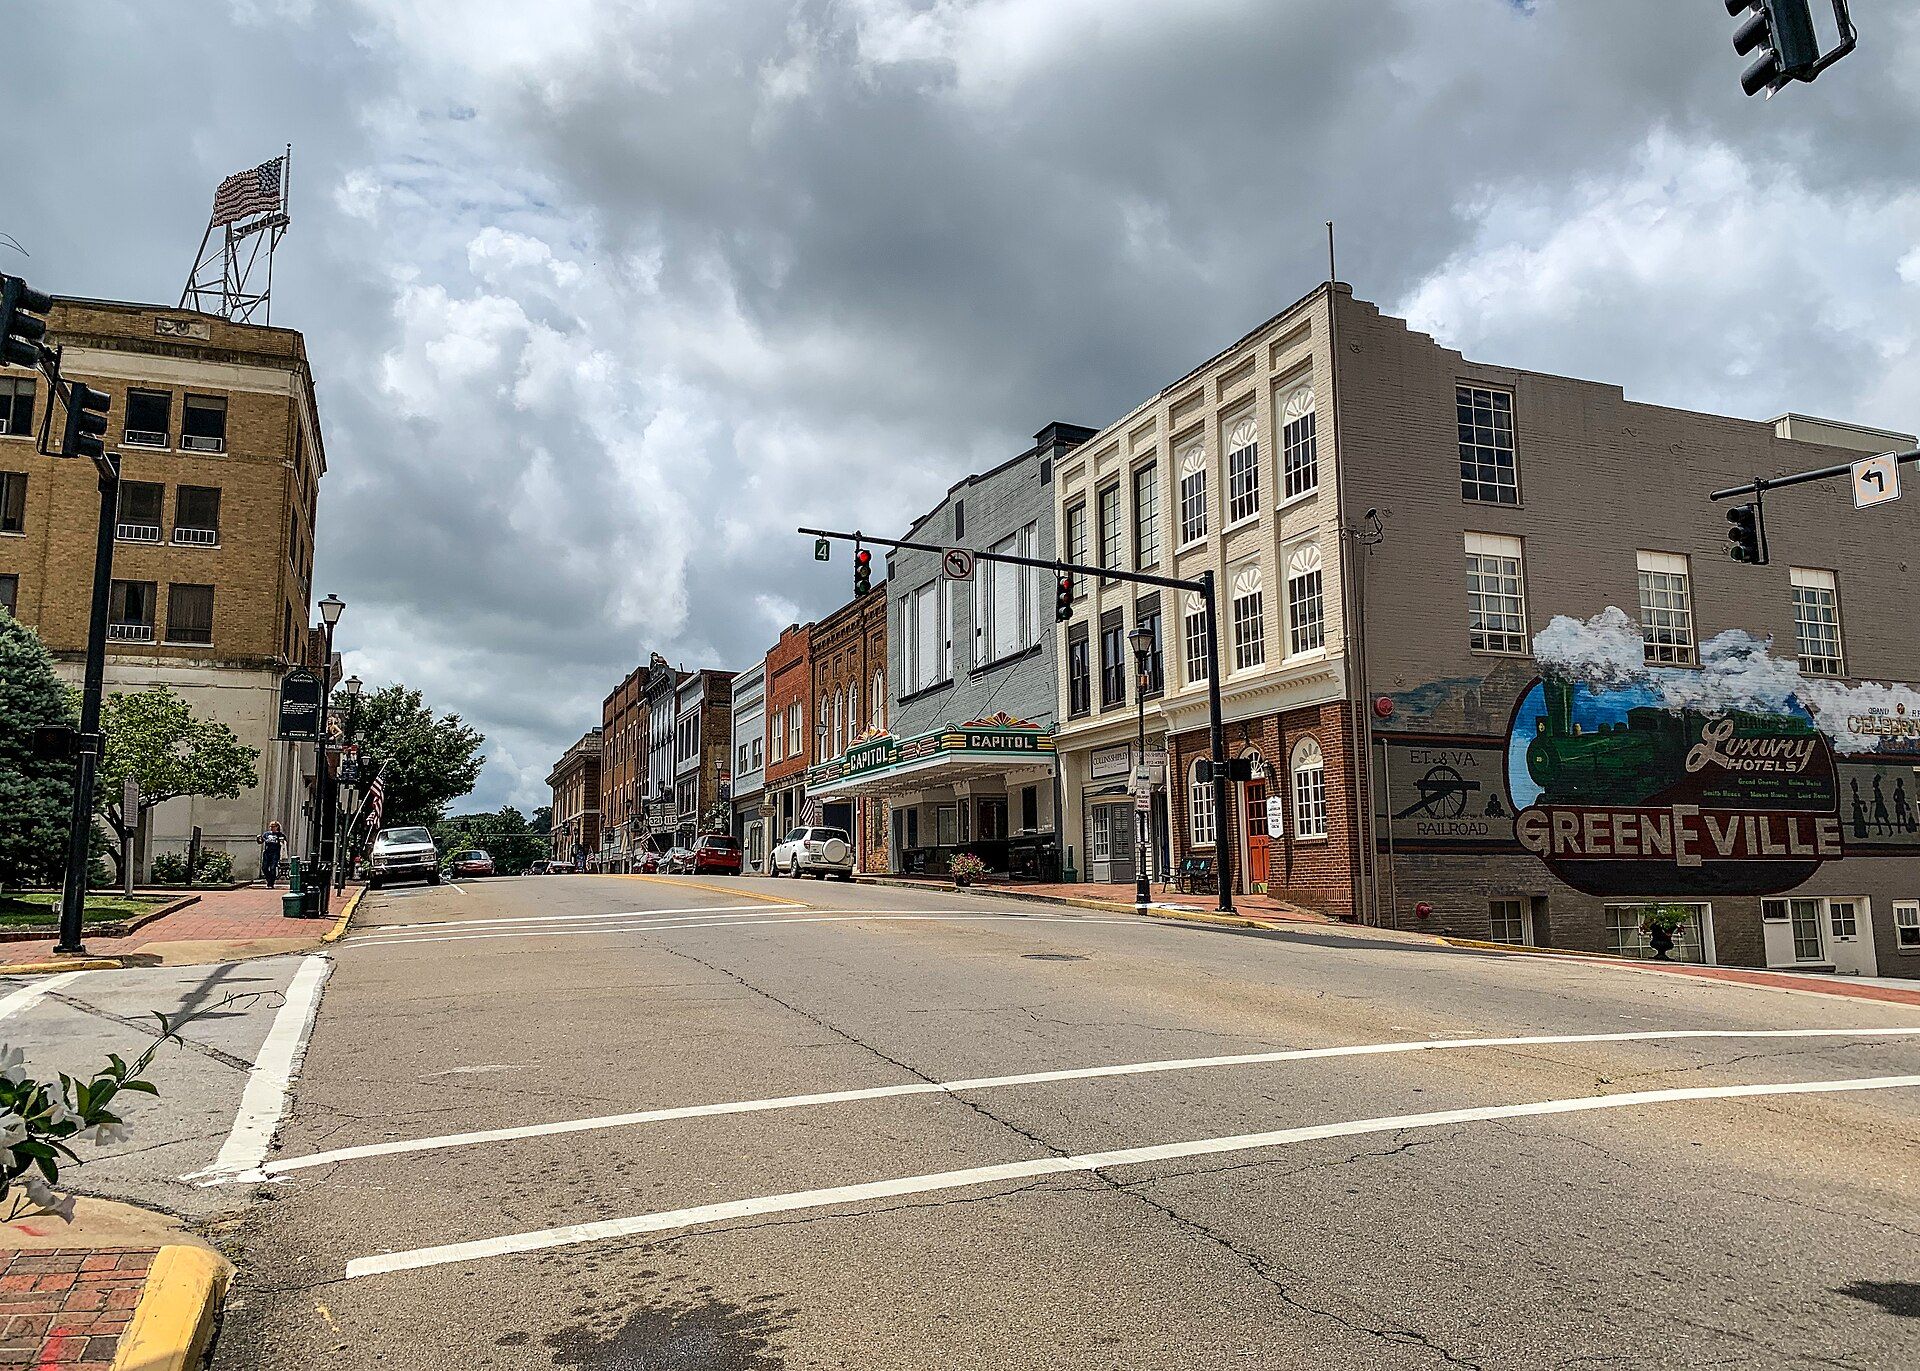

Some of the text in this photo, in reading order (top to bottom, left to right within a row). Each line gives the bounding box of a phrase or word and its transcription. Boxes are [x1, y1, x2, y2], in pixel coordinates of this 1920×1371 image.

[817, 544, 828, 560] 4
[971, 735, 1034, 749] CAPITOL
[1685, 719, 1817, 774] Luxury
[850, 745, 889, 771] CAPITOL
[1450, 751, 1480, 767] VA.
[1726, 759, 1798, 773] HOTELS
[650, 817, 662, 825] 321
[1416, 822, 1489, 836] RAILROAD
[1515, 803, 1842, 867] GREENEVILLE
